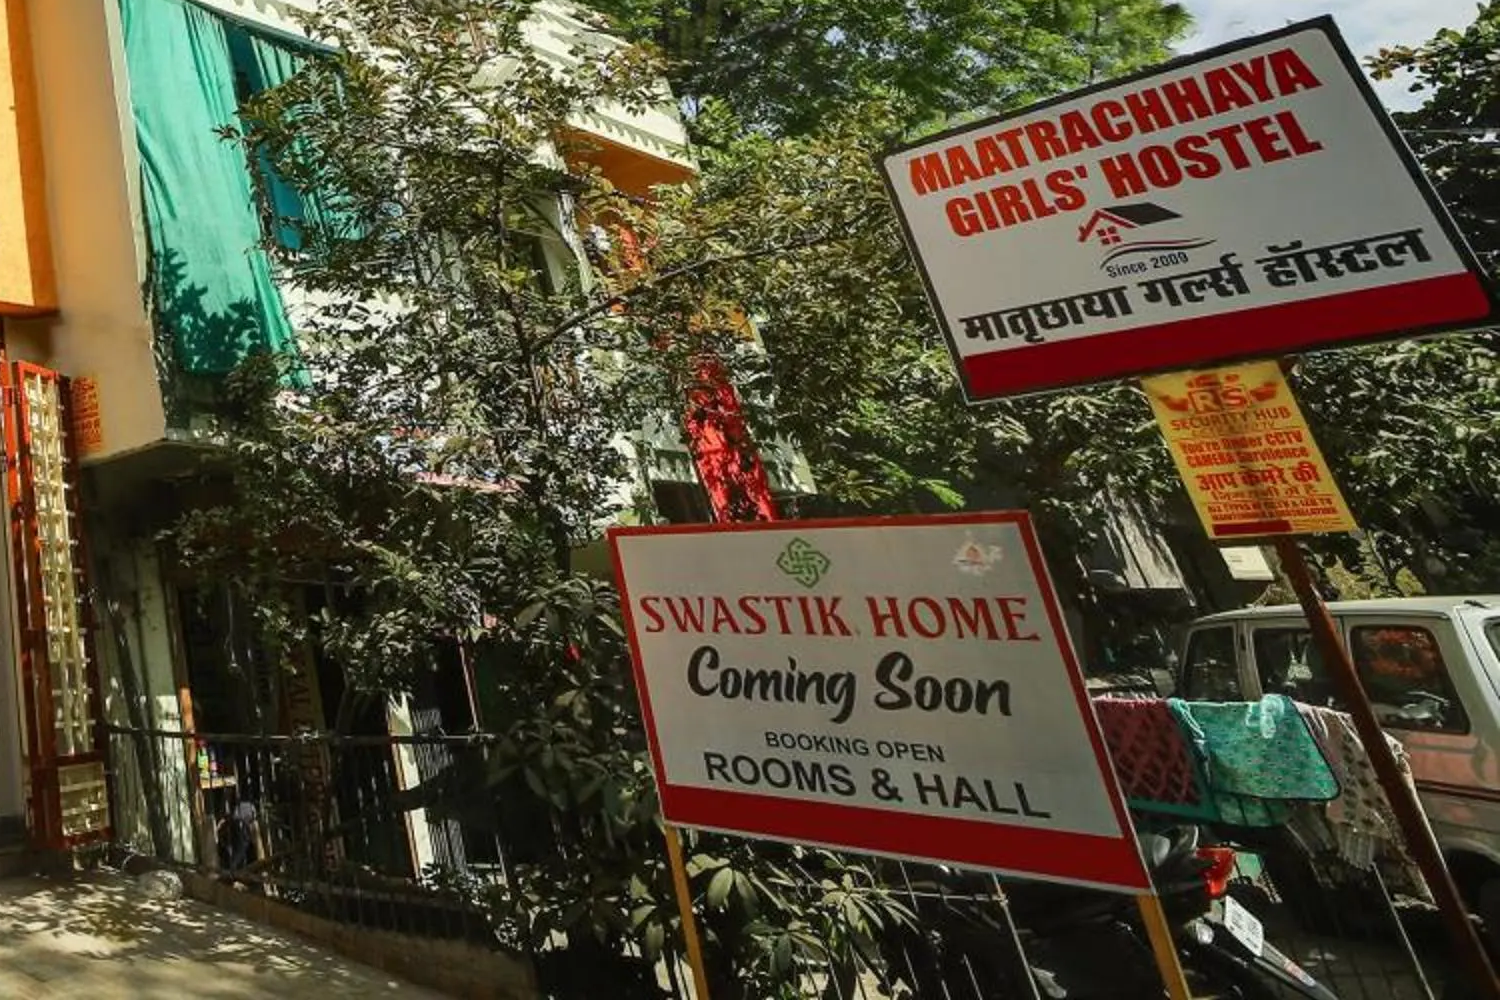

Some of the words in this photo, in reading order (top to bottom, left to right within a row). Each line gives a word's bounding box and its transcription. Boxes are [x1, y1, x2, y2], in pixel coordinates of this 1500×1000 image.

[908, 47, 1323, 197] MAATRACHHAYA
[945, 164, 1089, 237] GIRLS'
[1099, 109, 1324, 199] HOSTEL
[1106, 261, 1148, 278] Since
[1136, 252, 1250, 307] गर्ल्स
[1254, 228, 1433, 288] हॉस्टल
[1169, 411, 1249, 431] SECURITY
[1254, 406, 1292, 421] HUB
[1265, 430, 1303, 445] CCTV
[639, 595, 854, 637] SWASTIK
[867, 597, 1041, 642] HOME
[686, 645, 856, 724] Coming
[873, 651, 1012, 717] Soon
[764, 731, 869, 757] BOOKING
[876, 740, 946, 763] OPEN
[703, 752, 856, 797] ROOMS
[871, 767, 903, 803] &
[914, 774, 1052, 819] HALL
